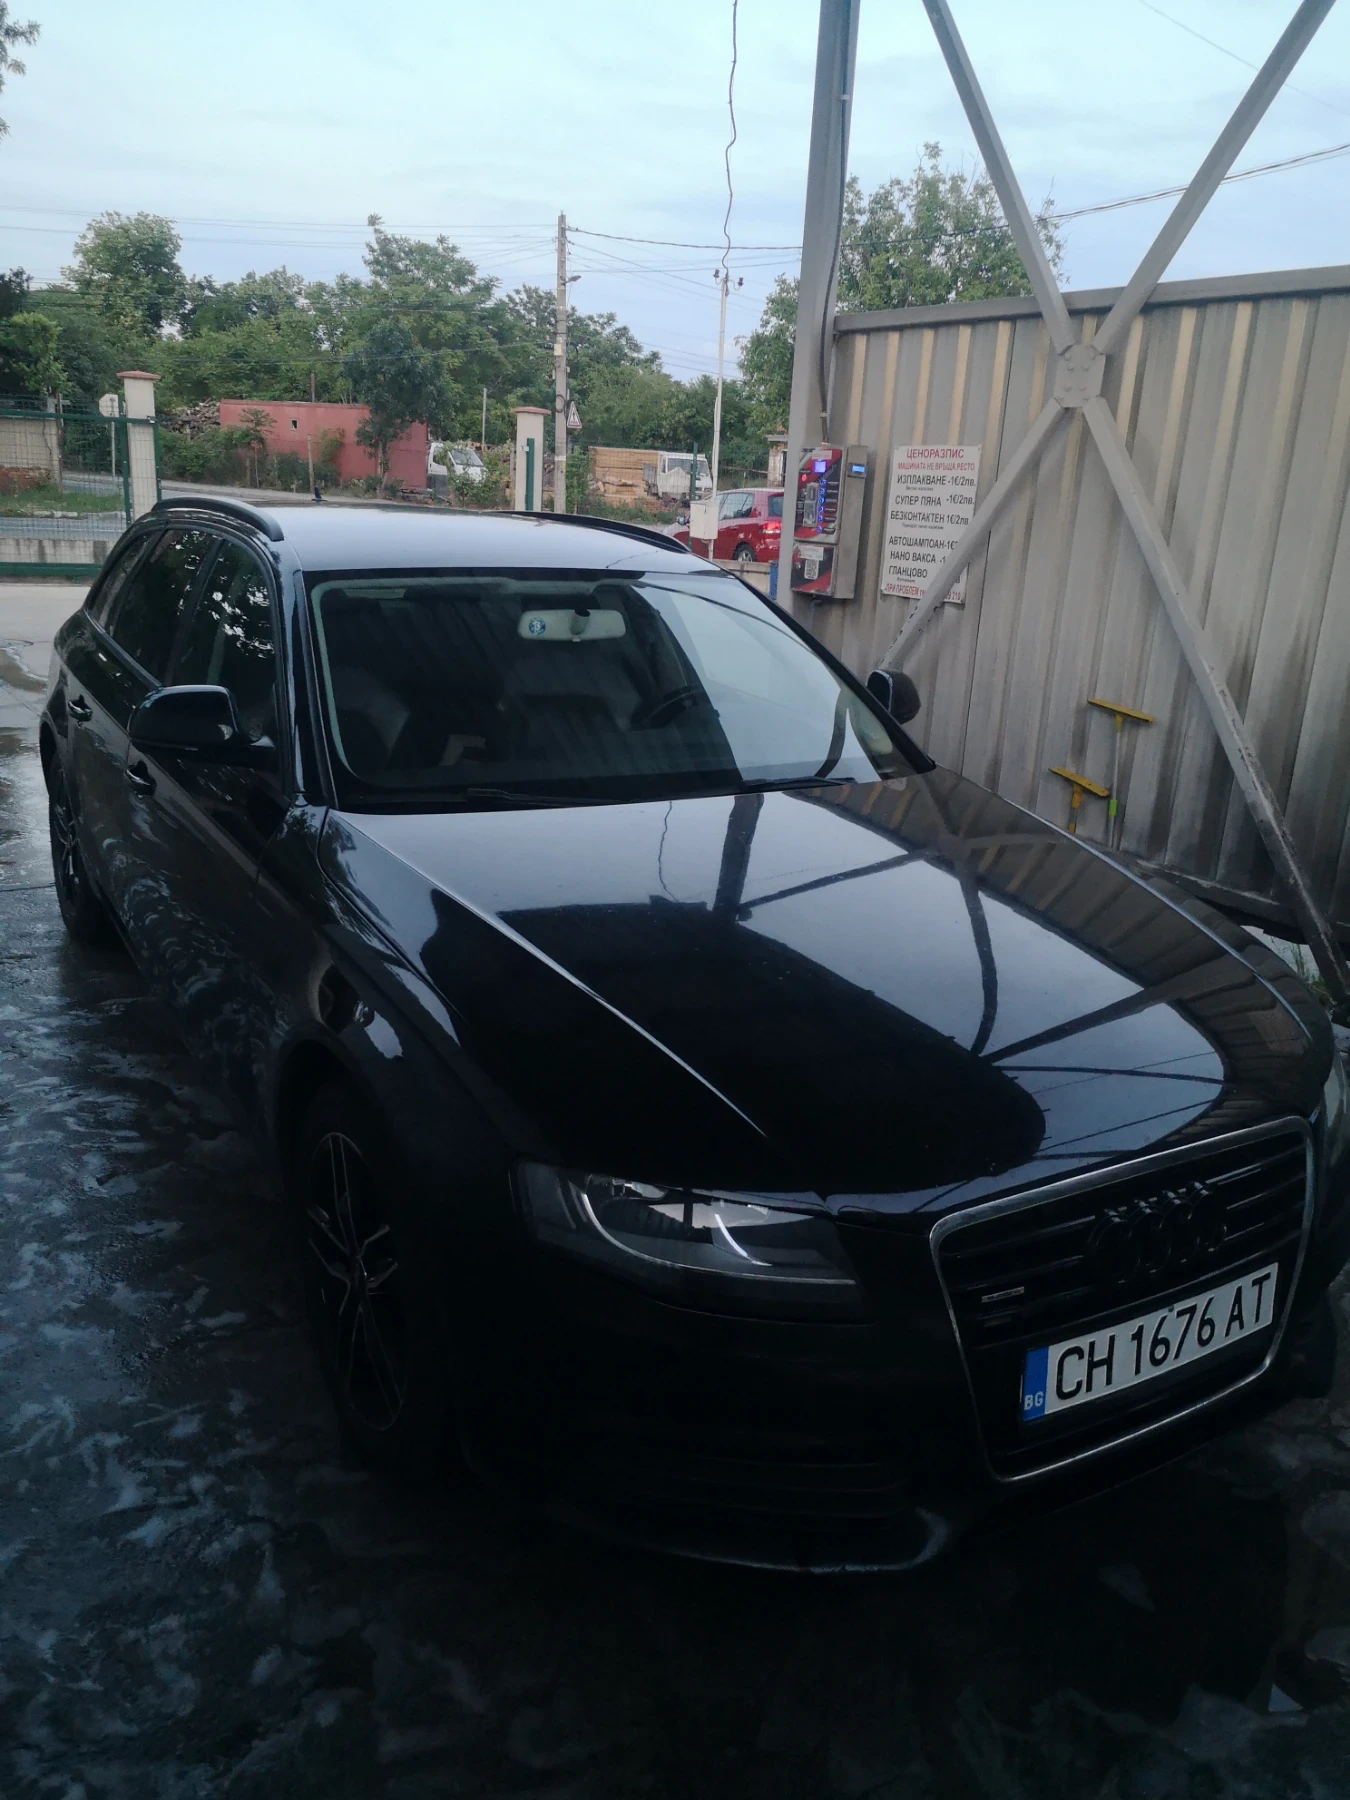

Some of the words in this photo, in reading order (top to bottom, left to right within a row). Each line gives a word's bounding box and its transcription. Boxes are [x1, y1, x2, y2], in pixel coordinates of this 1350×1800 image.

[906, 448, 965, 460] ЦЕНОРАЗПИС
[956, 462, 976, 471] РЕСТО
[897, 474, 947, 486] ИЗПЛАКВАНЕ
[895, 494, 920, 506] СУПЕР
[920, 496, 942, 507] ПЯНА
[890, 510, 945, 524] БЕЗКОНТАКТЕН
[890, 550, 911, 561] НАНО
[912, 552, 937, 564] ВАКСА
[888, 565, 928, 579] ГЛАНЦОВО
[1055, 1334, 1116, 1401] CH
[1130, 1295, 1216, 1377] 1676
[1224, 1271, 1272, 1338] AT
[1024, 1391, 1044, 1411] BG
